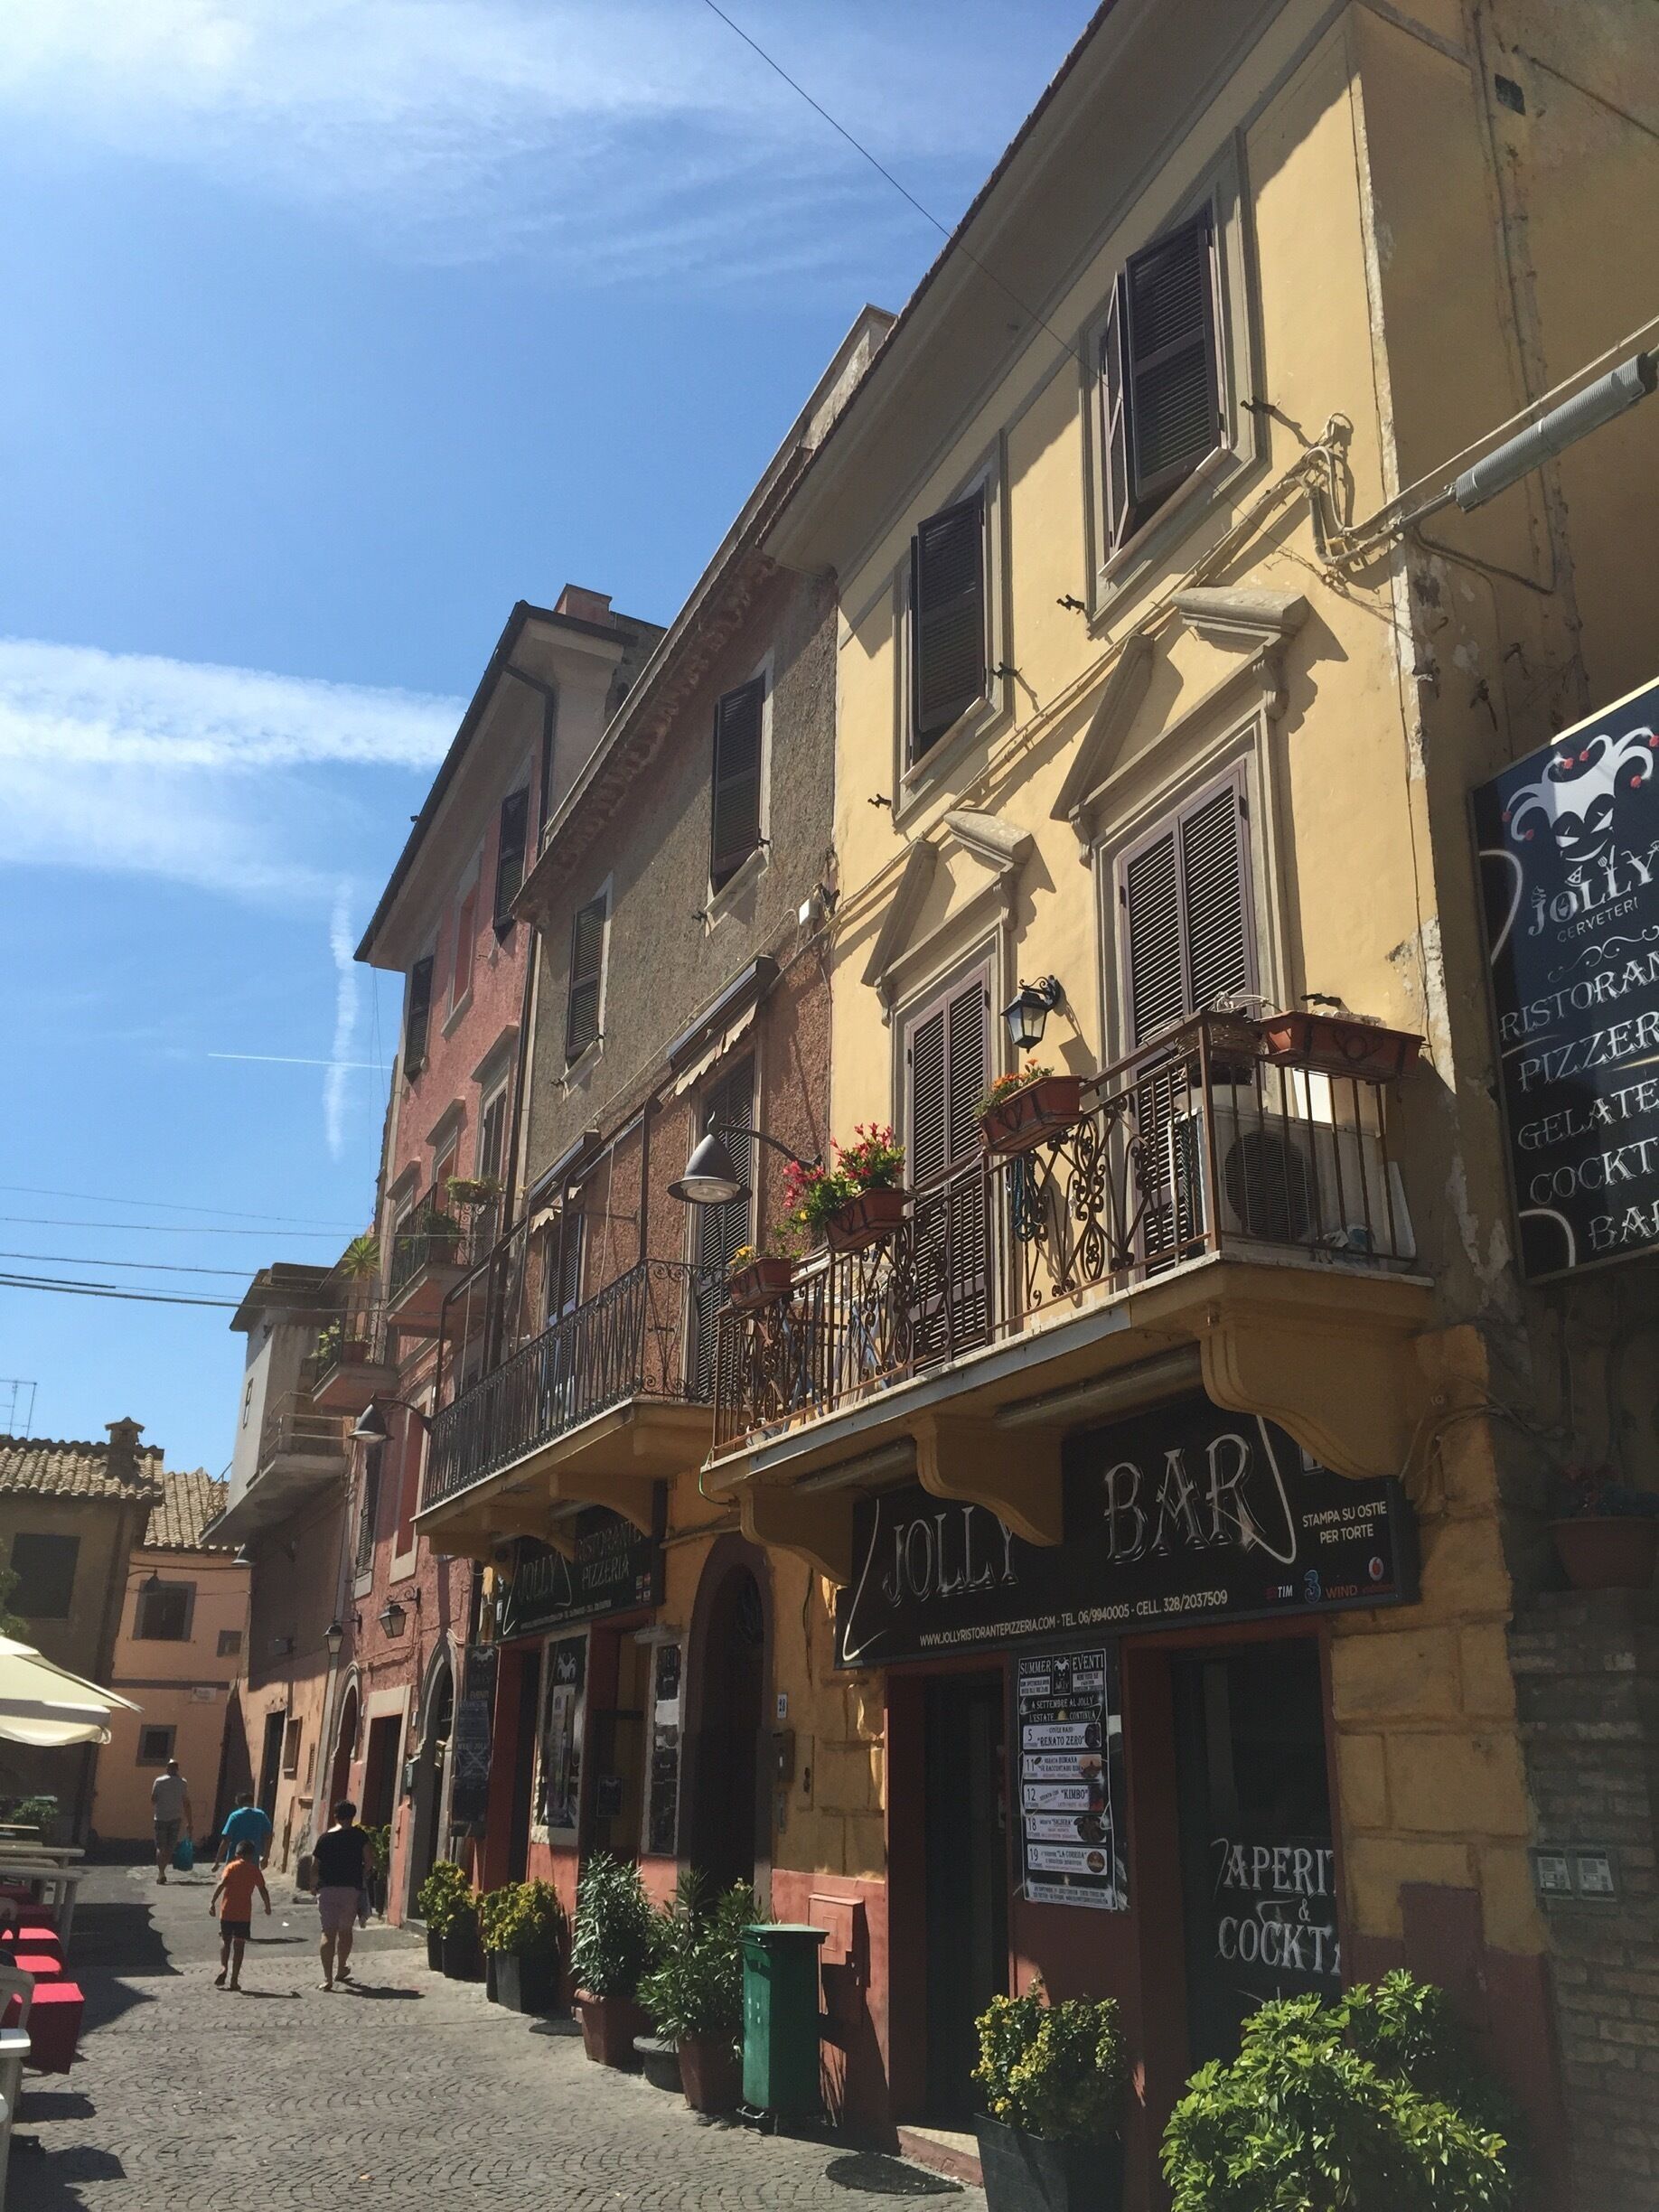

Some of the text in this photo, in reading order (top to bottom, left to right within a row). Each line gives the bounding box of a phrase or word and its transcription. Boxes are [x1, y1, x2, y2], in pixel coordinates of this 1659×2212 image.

[1557, 896, 1638, 942] CERVETERI
[1103, 1434, 1265, 1564] BAR
[1302, 1501, 1387, 1528] STAMPA SU OSTIE
[1319, 1523, 1374, 1544] PER TORTE
[582, 1553, 630, 1590] PIZZERIA
[1278, 1585, 1293, 1598] TIM
[1325, 1585, 1358, 1598] WIND
[920, 1616, 1055, 1646] WWW.JOLLYRISTORANTEPIZZERIA.COM
[1078, 1604, 1129, 1625] 06/9940005
[1163, 1589, 1228, 1613] 328/2037509
[1020, 1654, 1103, 1675] SUMMER EVENTI
[1036, 1699, 1068, 1710] SETTEMBRE
[1077, 1695, 1094, 1707] JOLLY
[1027, 1788, 1036, 1802] 12
[1028, 1818, 1036, 1831] 18
[1030, 1849, 1038, 1861] 19
[1298, 1898, 1311, 1922] &
